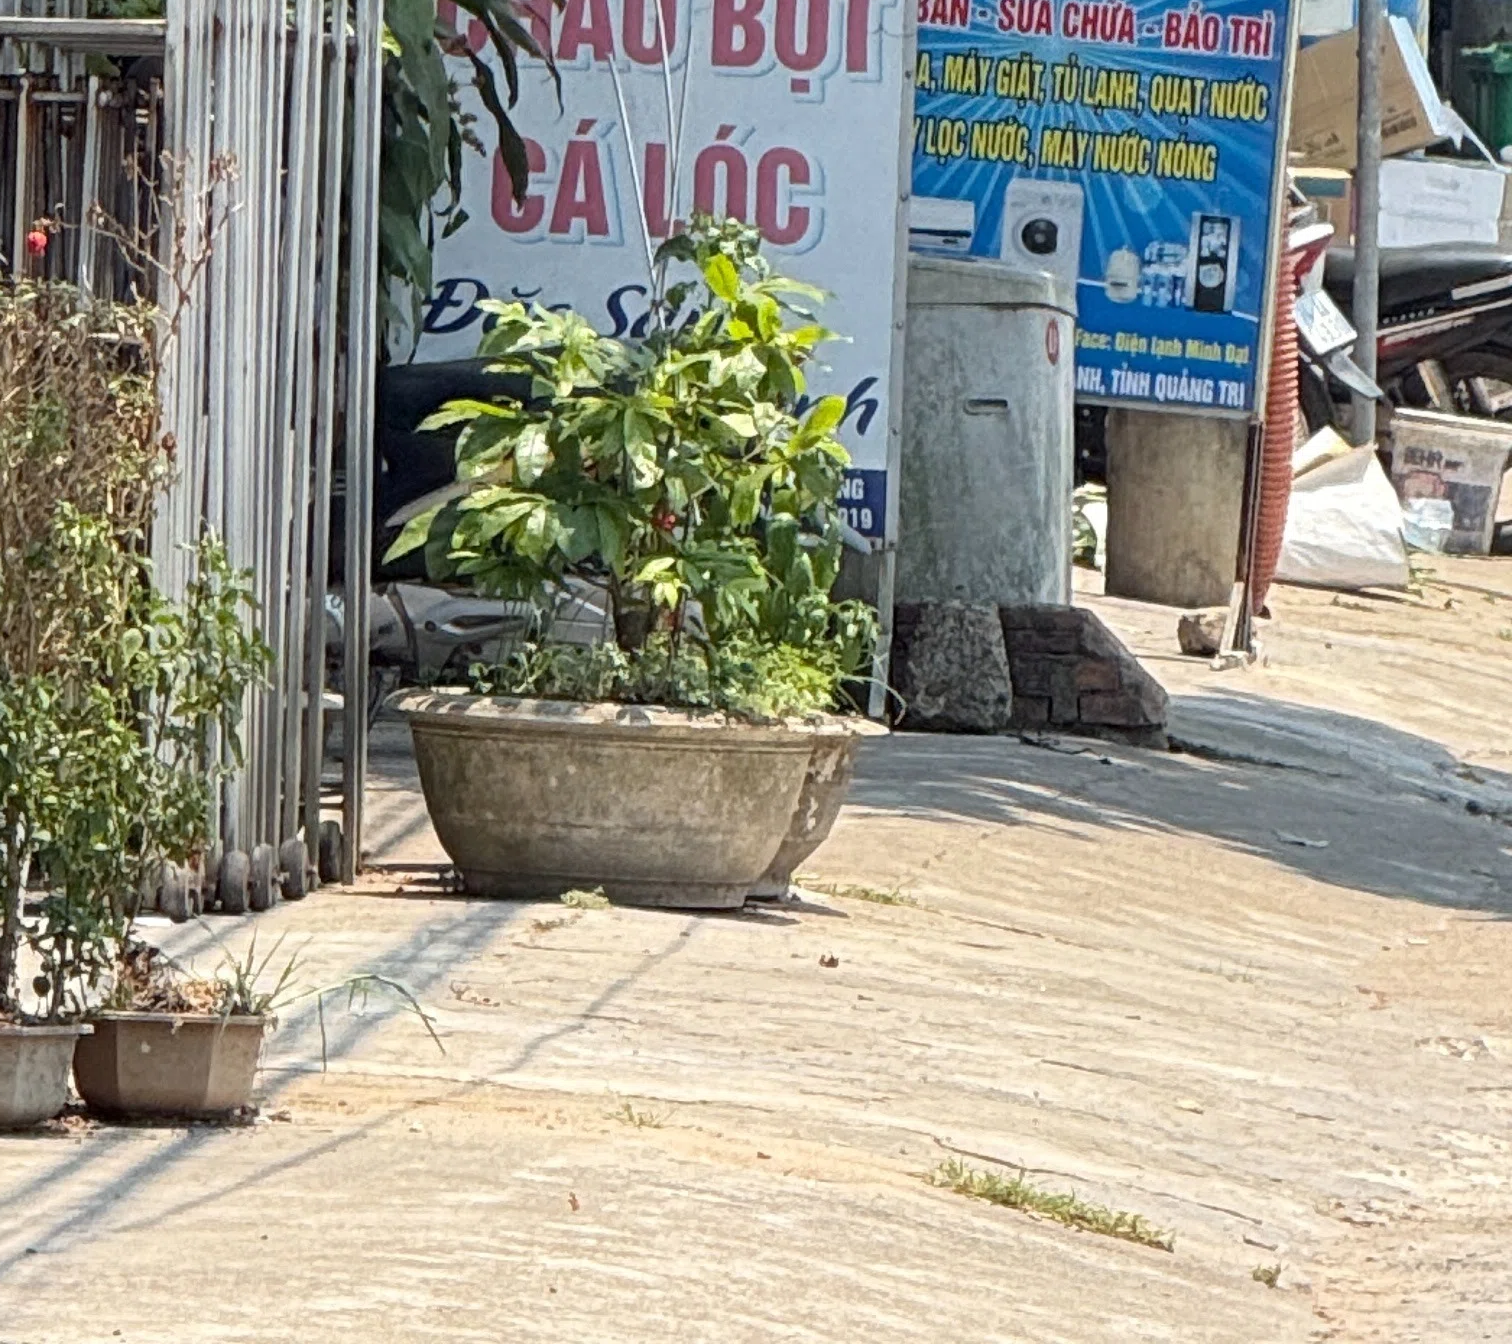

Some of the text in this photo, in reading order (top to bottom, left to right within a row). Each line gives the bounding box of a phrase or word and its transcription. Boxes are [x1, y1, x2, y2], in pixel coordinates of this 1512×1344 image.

[1164, 0, 1220, 54] BẢO
[1229, 11, 1275, 58] TRÌ
[944, 48, 991, 95] MÁY
[1053, 52, 1080, 103] TỦ
[1150, 72, 1206, 125] QUẠT
[1210, 70, 1271, 122] NƯỚC
[491, 119, 811, 246] CÁ LÓC
[925, 118, 966, 166] LỌC
[1041, 122, 1089, 170] MÁY
[1092, 127, 1151, 176] NƯỚC
[1156, 134, 1218, 181] NÓNG
